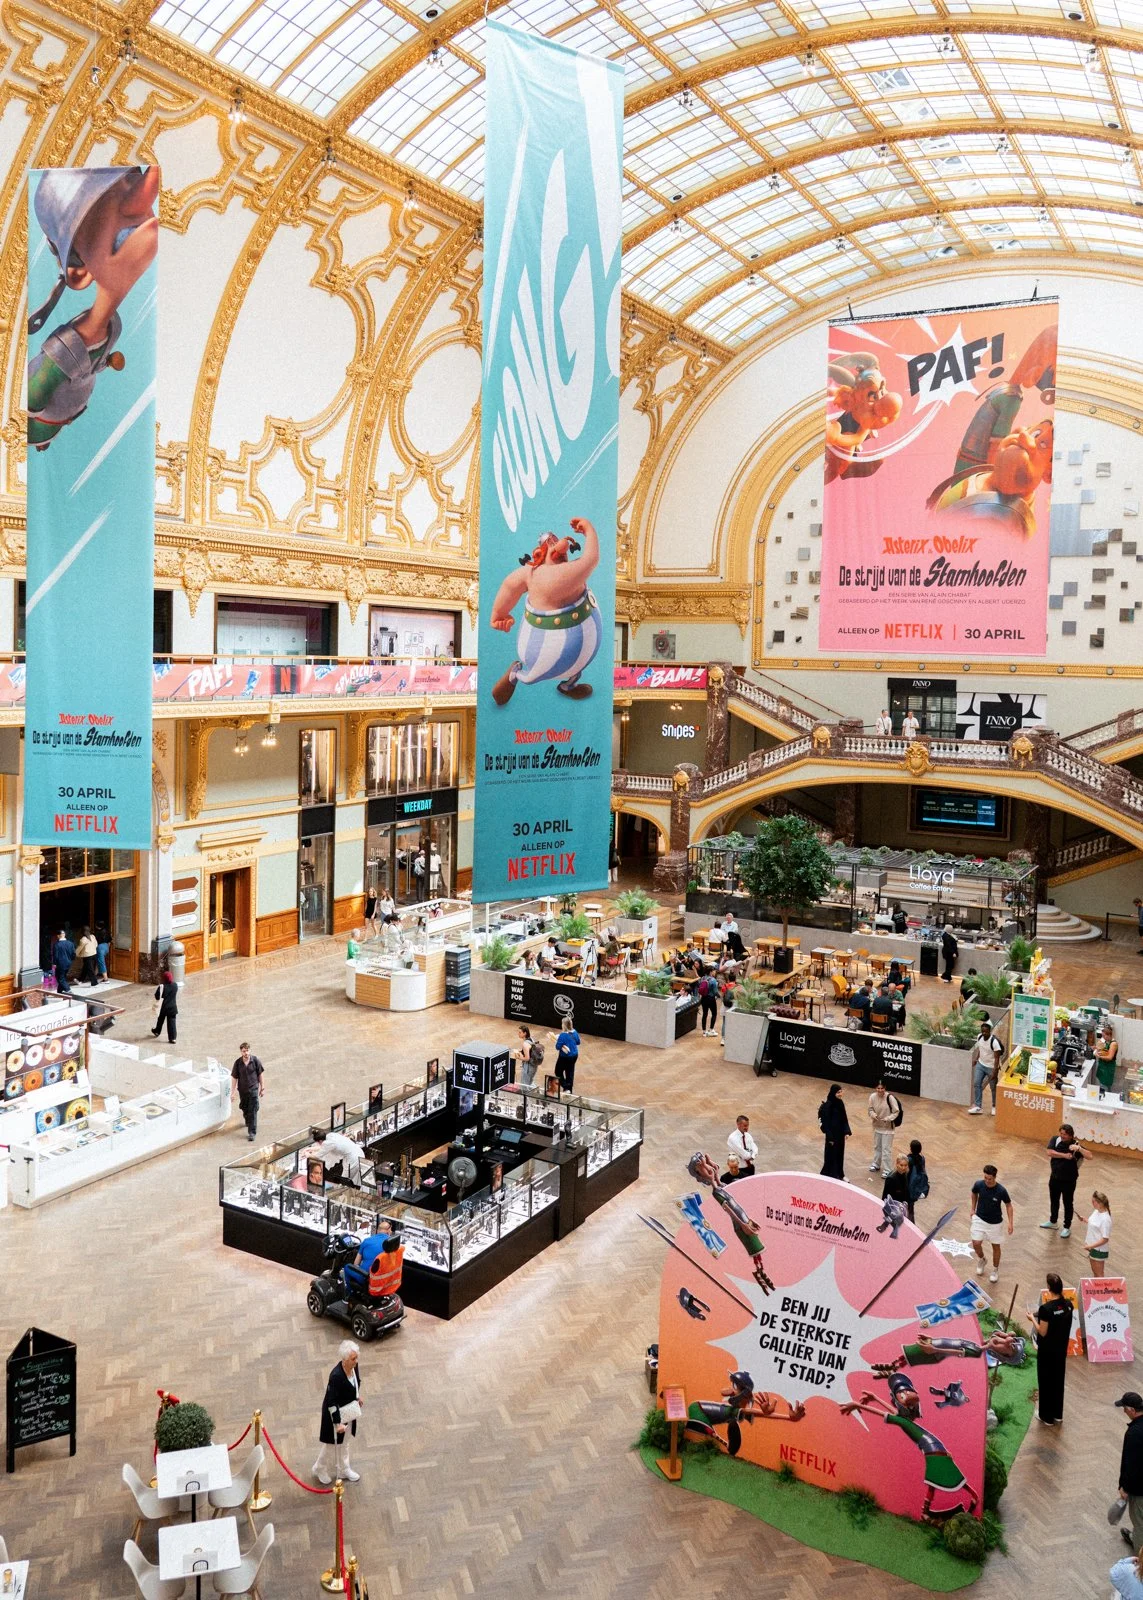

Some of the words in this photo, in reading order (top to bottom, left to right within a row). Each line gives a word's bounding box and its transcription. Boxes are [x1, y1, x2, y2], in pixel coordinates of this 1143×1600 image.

[908, 332, 1004, 397] PAF!
[882, 536, 930, 555] Asterix
[933, 536, 980, 554] Obelix
[839, 566, 851, 586] De
[855, 566, 885, 591] strijd
[888, 568, 906, 586] van
[910, 566, 921, 586] de
[924, 556, 1027, 588] Stamhoofden
[884, 623, 943, 640] NETFLIX
[964, 628, 980, 639] 30
[984, 629, 1025, 640] APRIL
[188, 665, 233, 697] PAF!
[650, 668, 705, 688] BAM!
[88, 714, 114, 726] Obelix
[985, 716, 1017, 726] INNO
[33, 731, 40, 744] De
[42, 731, 61, 748] strijd
[63, 732, 74, 744] van
[75, 732, 82, 745] de
[83, 727, 142, 747] Stamhoofden
[514, 729, 544, 744] Asterix
[546, 728, 573, 743] Obelix
[662, 724, 695, 739] snipes
[485, 754, 493, 771] De
[495, 754, 516, 774] strijd
[518, 754, 530, 769] van
[532, 753, 540, 768] de
[541, 744, 601, 769] Stamhoofden
[58, 787, 74, 797] 30
[77, 788, 116, 799] APRIL
[404, 799, 432, 813] WEEKDAY
[54, 814, 118, 834] NETFLIX
[513, 823, 529, 836] 30
[533, 819, 573, 835] APRIL
[521, 842, 552, 852] ALLEEN
[554, 840, 565, 849] OP
[508, 853, 576, 882] NETFLIX
[910, 865, 954, 884] Lloyd
[909, 882, 931, 891] Coffee
[933, 885, 953, 893] Eatery
[594, 1000, 616, 1011] Lloyd
[780, 1032, 806, 1045] Lloyd
[872, 1040, 912, 1054] PANCAKES
[883, 1051, 912, 1062] SALADS
[460, 1062, 478, 1071] TWICE
[494, 1060, 506, 1070] TWICE
[884, 1060, 912, 1071] TOASTS
[462, 1075, 476, 1083] NICE
[495, 1073, 504, 1082] NICE
[1004, 1090, 1029, 1101] FRESH
[1032, 1096, 1054, 1106] JUICE
[1023, 1101, 1054, 1113] COFFEE
[790, 1196, 817, 1211] Asterix
[819, 1202, 844, 1217] Obelix
[766, 1206, 774, 1219] De
[775, 1210, 792, 1226] strijd
[794, 1213, 804, 1226] van
[805, 1216, 812, 1229] de
[814, 1215, 870, 1243] Stamhoofden
[781, 1297, 809, 1317] BEN
[811, 1305, 830, 1323] JIJ
[760, 1312, 778, 1329] DE
[781, 1318, 851, 1350] STERKSTE
[1100, 1323, 1118, 1333] 985
[759, 1334, 814, 1362] GALLIËR
[818, 1350, 847, 1371] VAN
[774, 1357, 786, 1374] 'T
[789, 1363, 835, 1389] STAD?
[780, 1444, 837, 1477] NETFLIX
